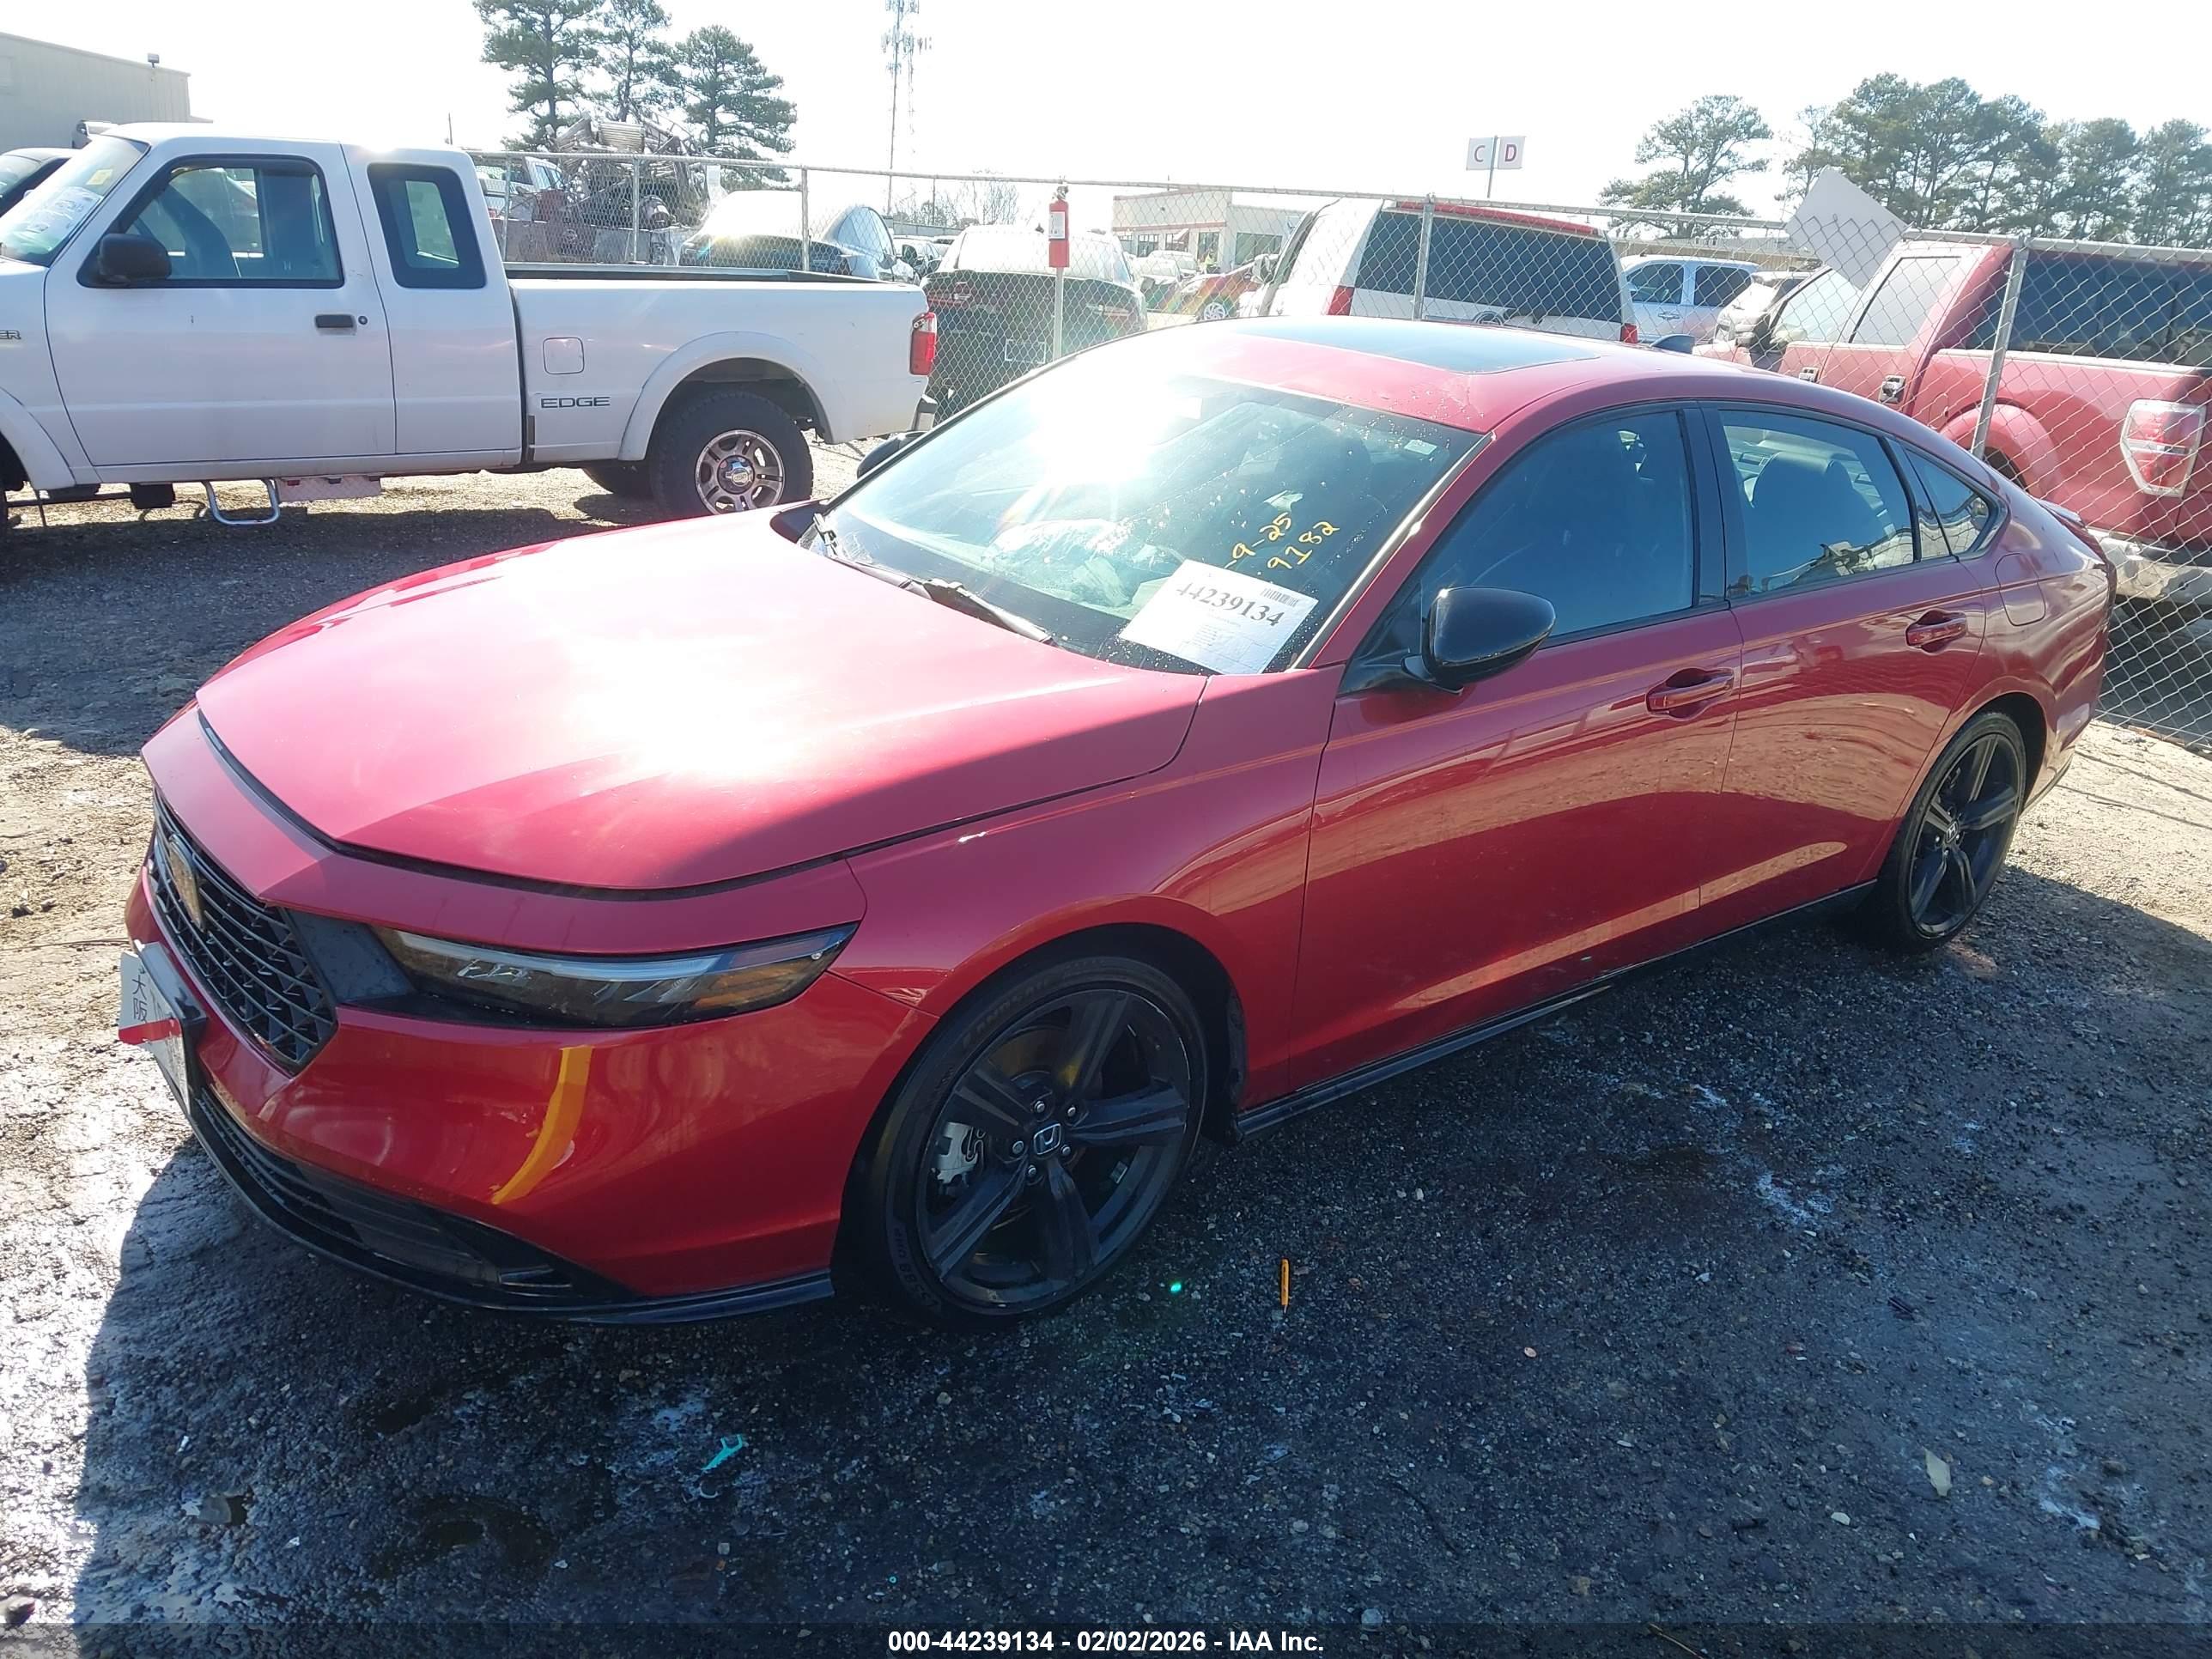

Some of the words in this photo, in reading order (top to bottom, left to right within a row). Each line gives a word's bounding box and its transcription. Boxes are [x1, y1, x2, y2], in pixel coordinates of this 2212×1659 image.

[1474, 144, 1486, 163] C
[1504, 143, 1517, 162] D
[540, 396, 611, 409] EDGE
[1176, 581, 1285, 628] 44239134
